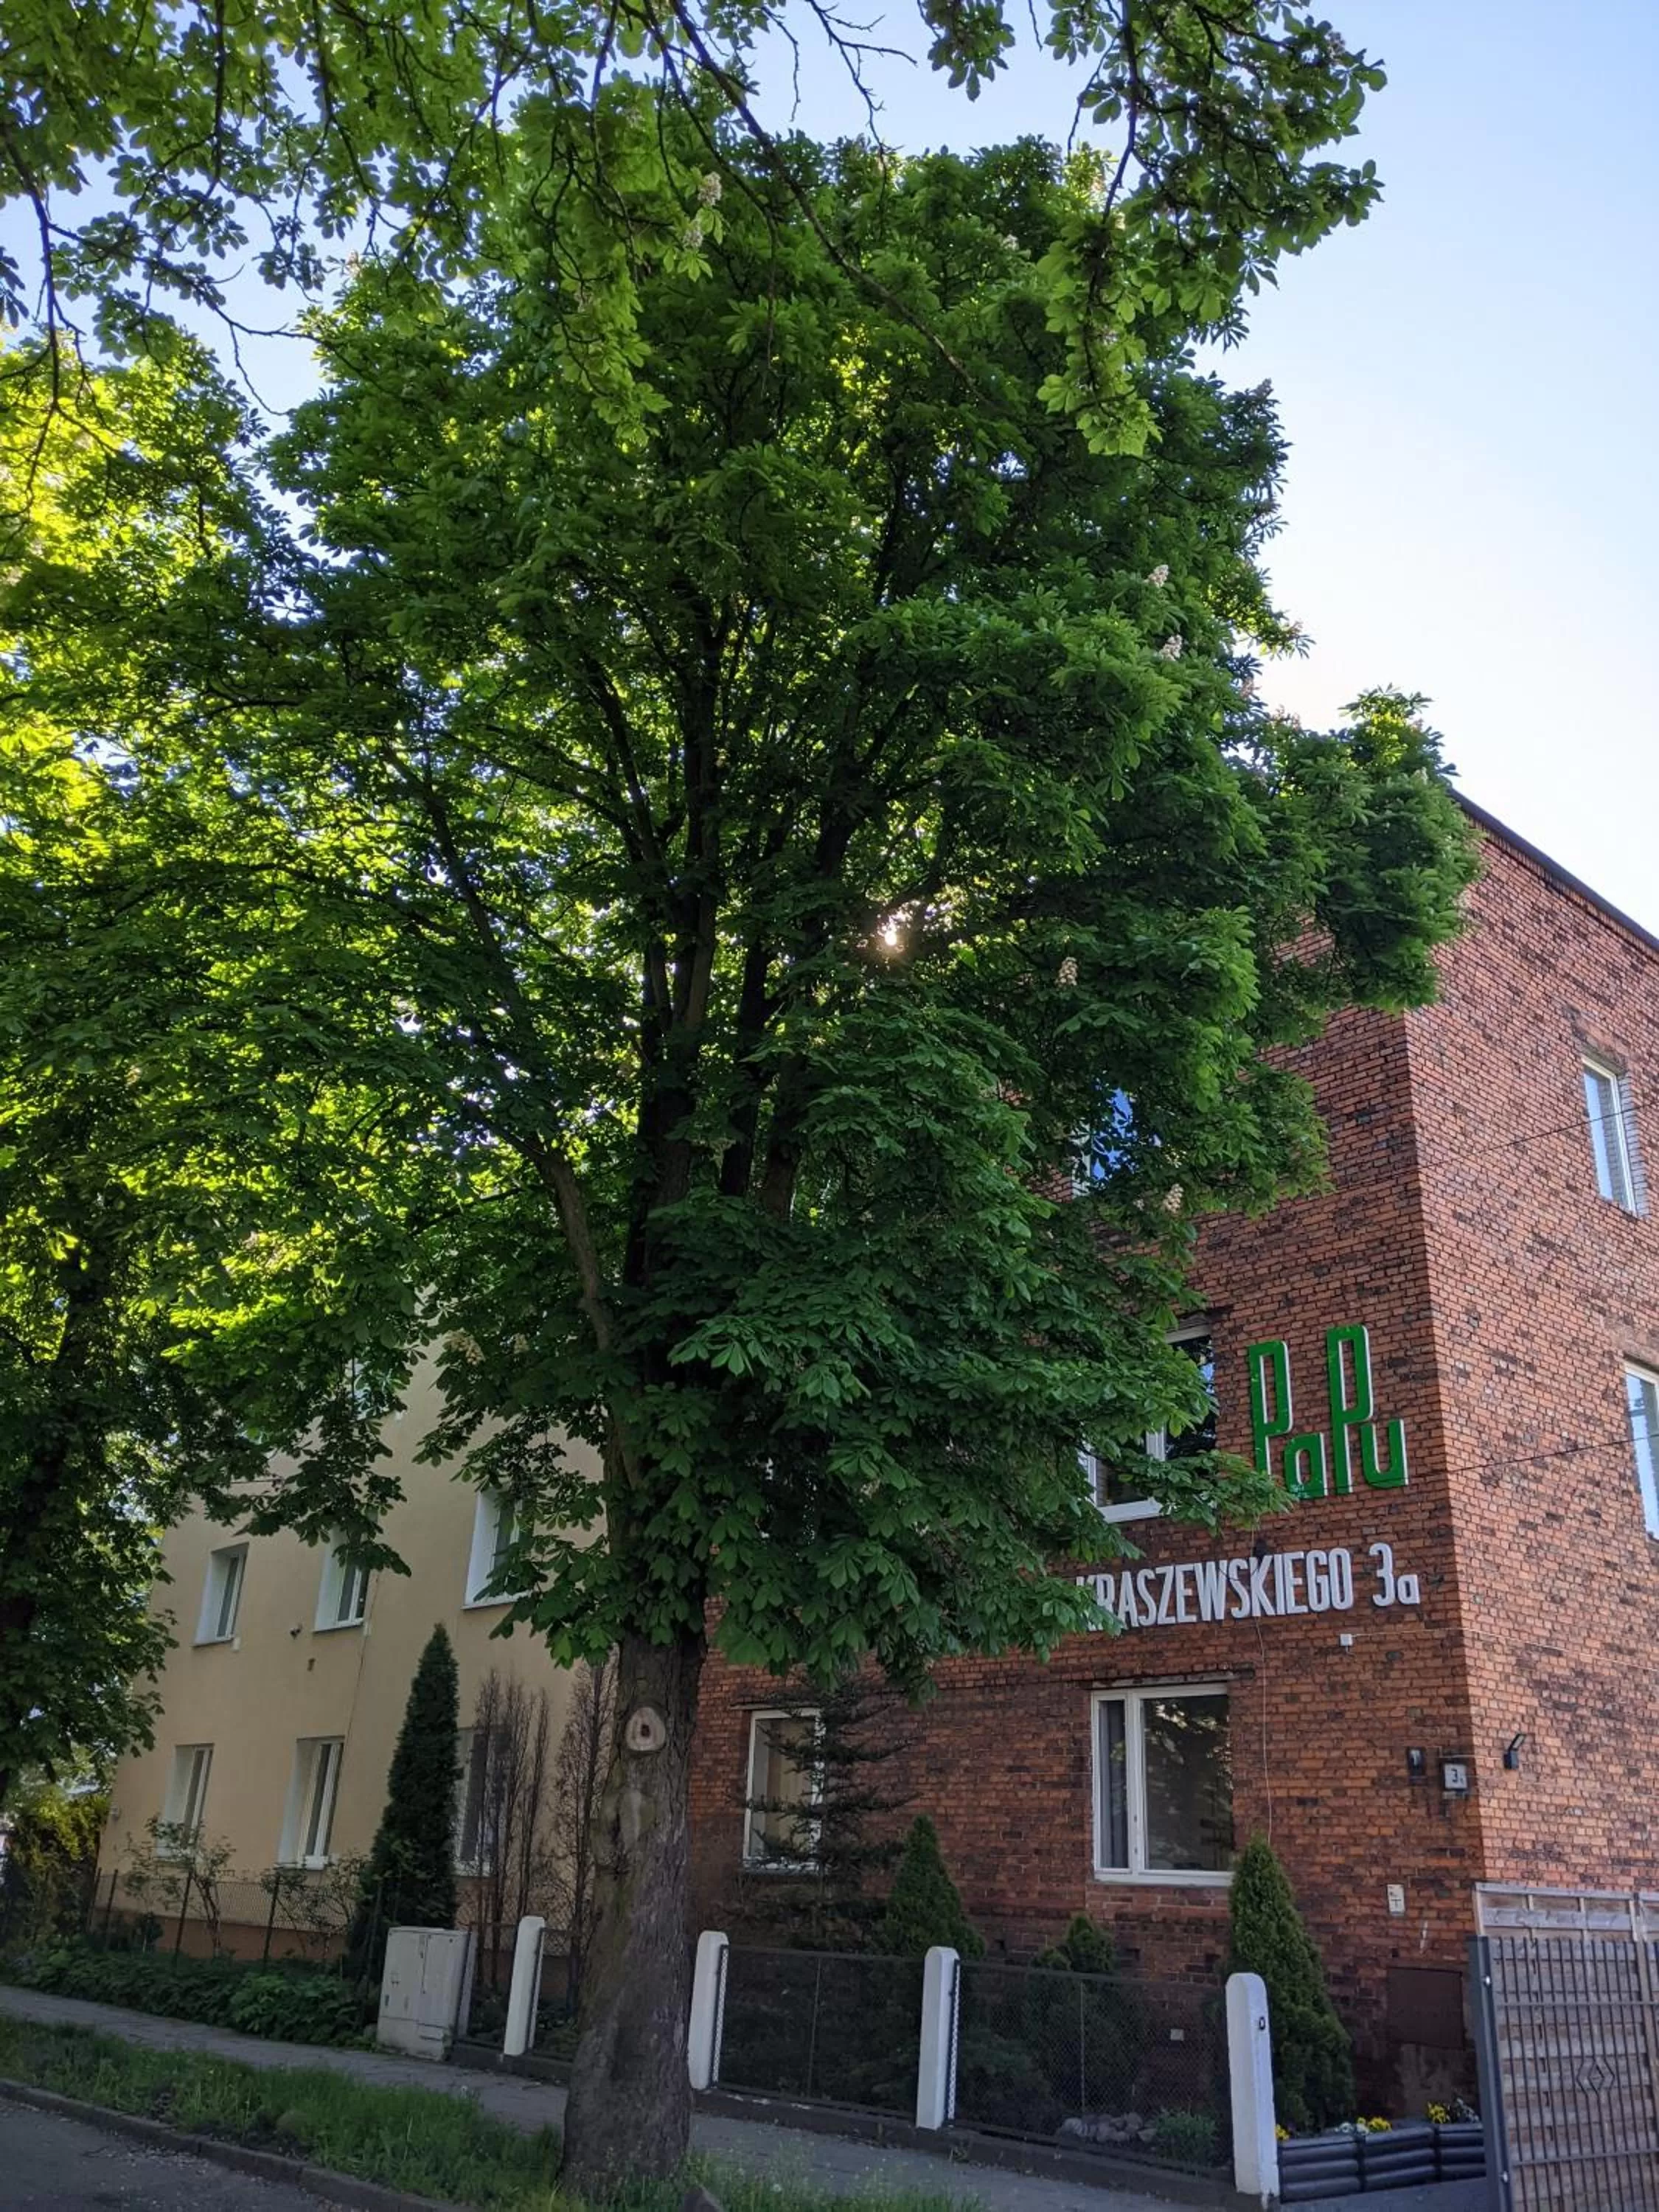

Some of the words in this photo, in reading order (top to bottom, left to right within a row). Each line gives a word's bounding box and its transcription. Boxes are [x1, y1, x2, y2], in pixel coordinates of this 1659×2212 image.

[1248, 1324, 1409, 1499] PaPu
[1077, 1548, 1354, 1631] RASZEWSKIEGO
[1369, 1543, 1420, 1607] 3a
